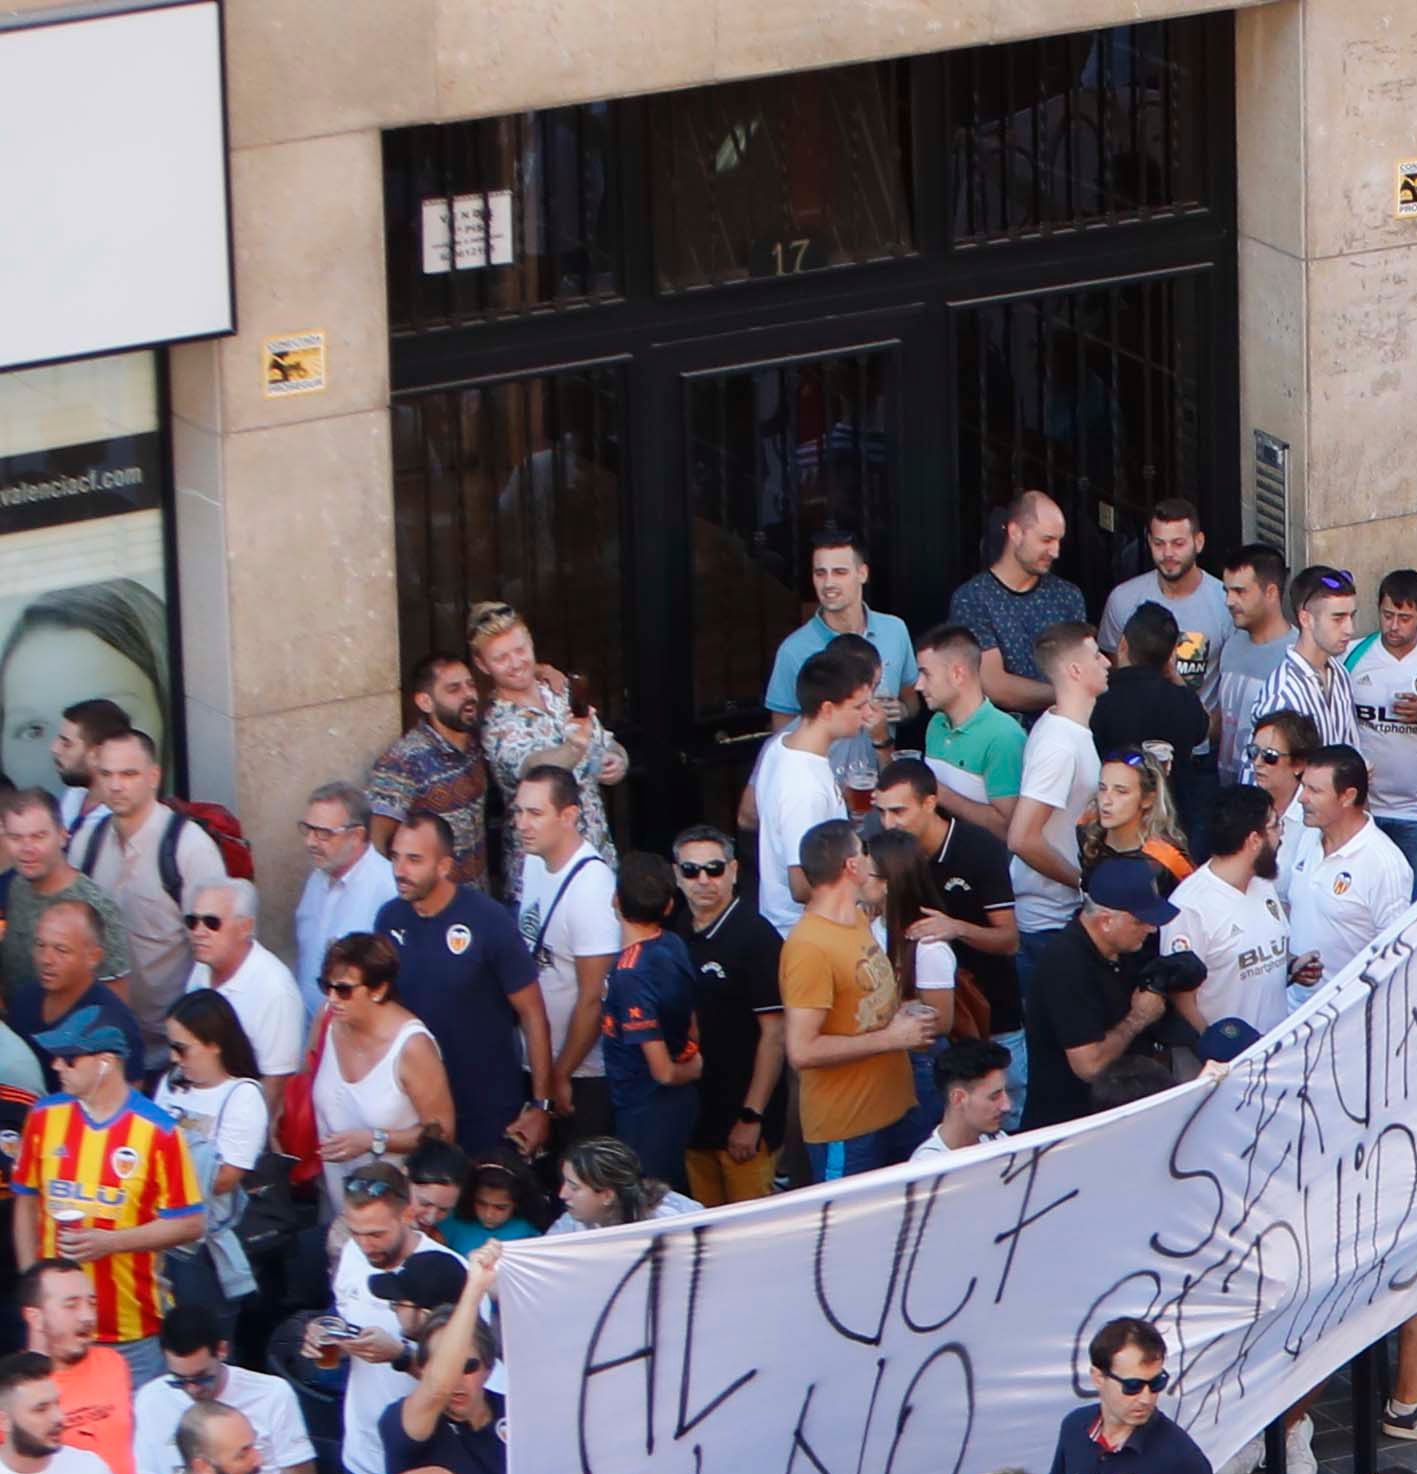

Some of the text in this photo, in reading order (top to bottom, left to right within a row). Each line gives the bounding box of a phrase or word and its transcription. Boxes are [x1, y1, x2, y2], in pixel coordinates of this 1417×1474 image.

[770, 239, 812, 277] 17
[1237, 936, 1286, 970] BLÜ
[48, 1179, 127, 1207] BLÜ
